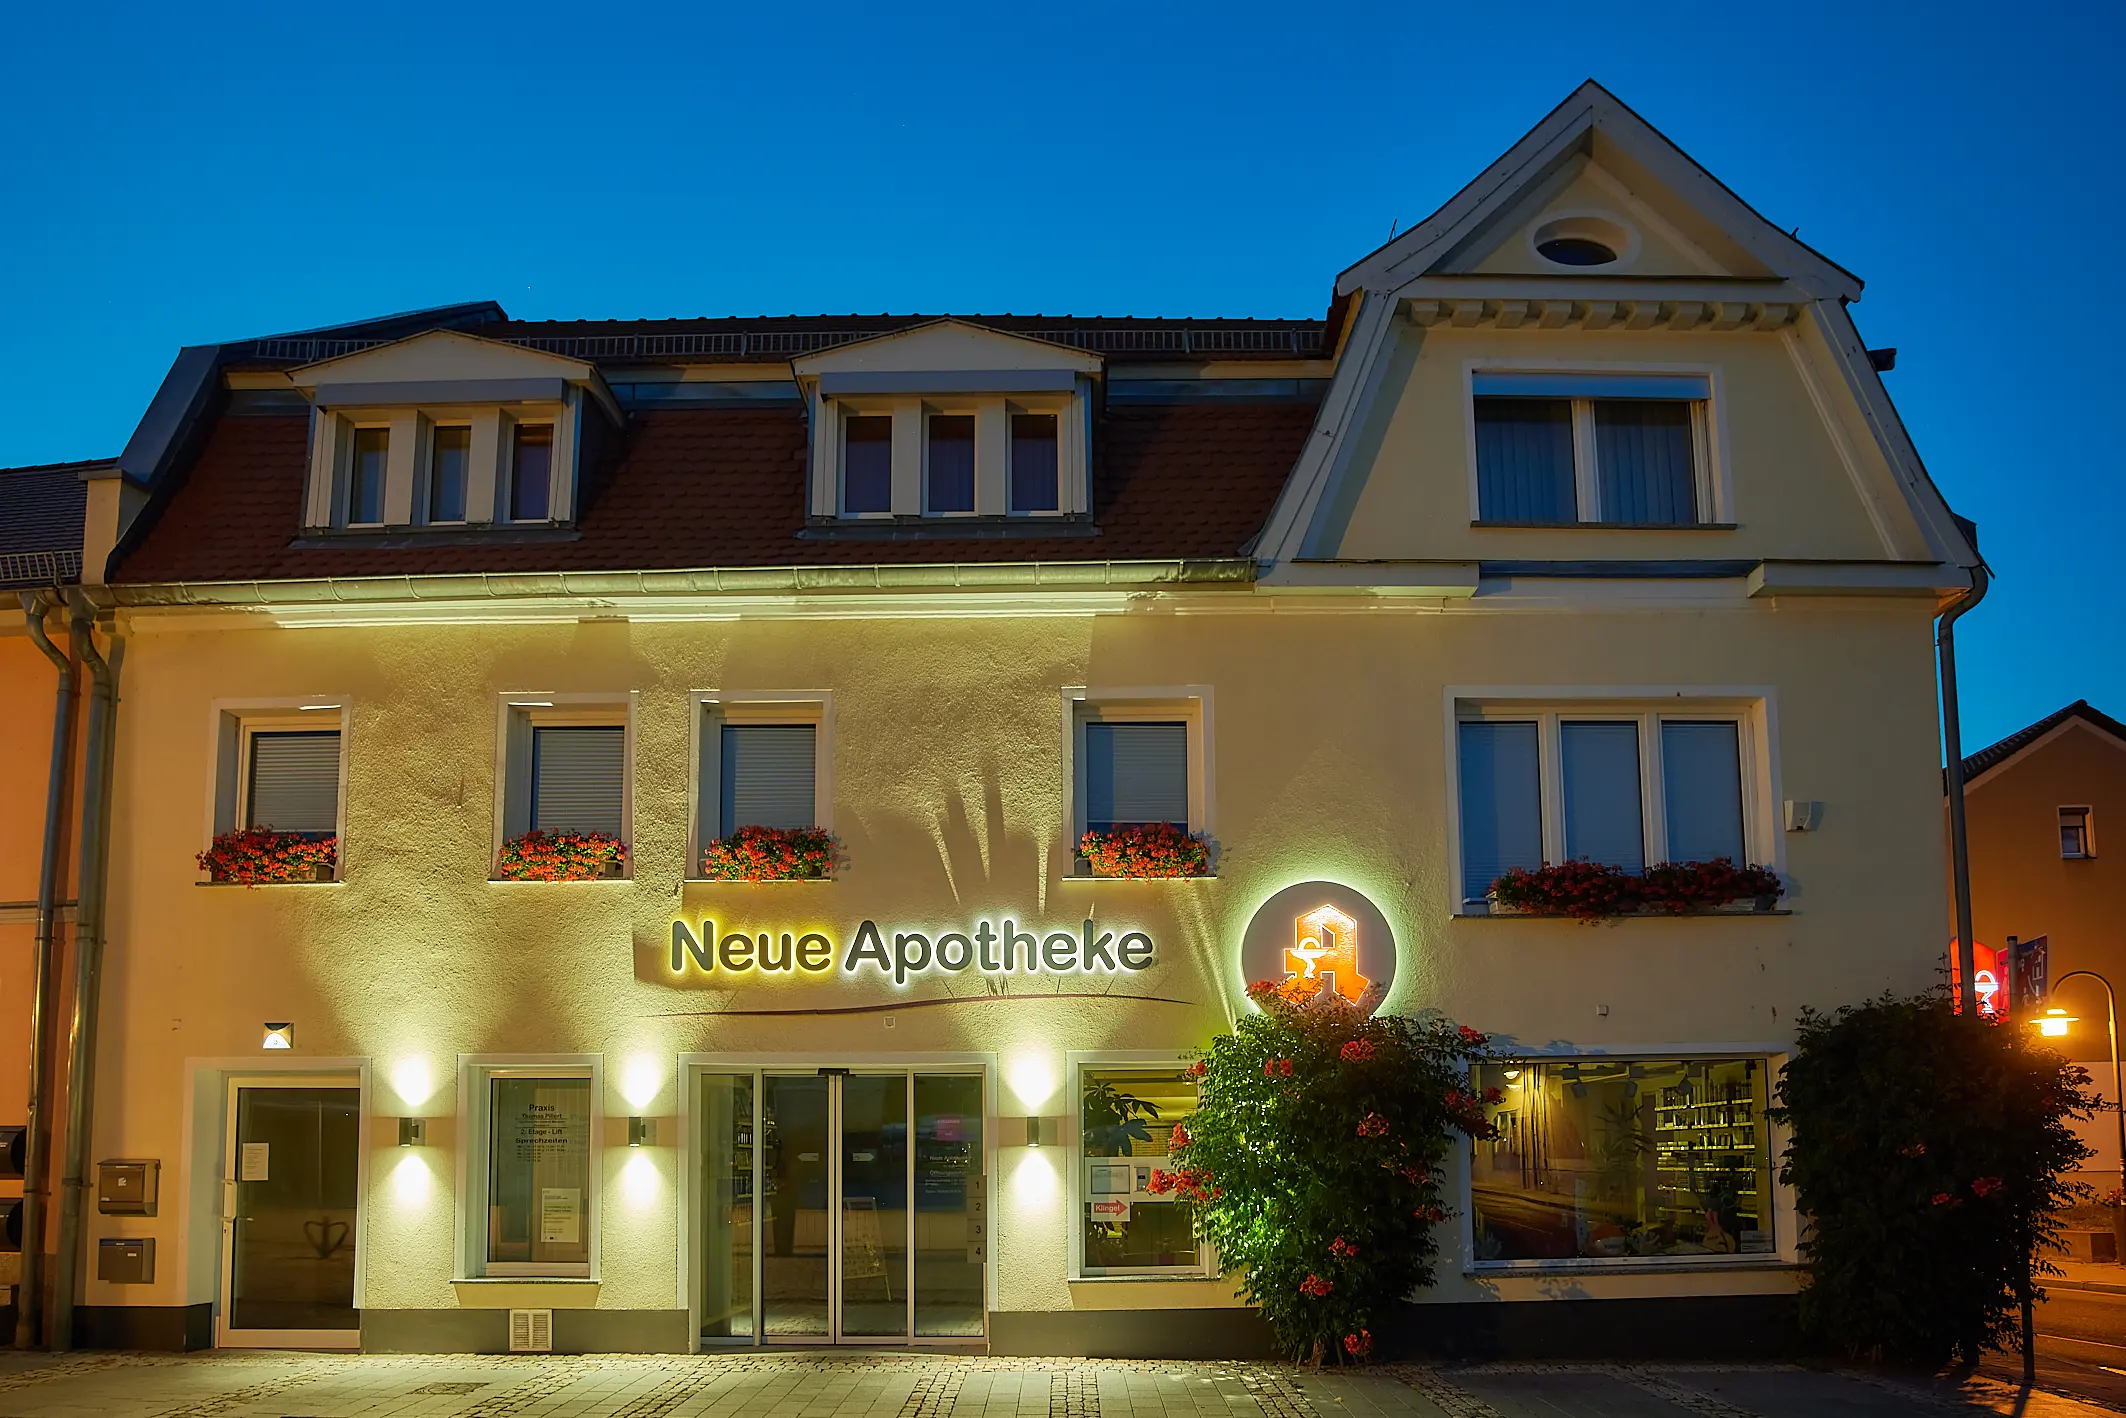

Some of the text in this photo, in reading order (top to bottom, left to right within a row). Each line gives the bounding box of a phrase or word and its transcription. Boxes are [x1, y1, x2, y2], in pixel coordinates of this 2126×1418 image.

[671, 920, 1154, 985] Neue Apotheke
[529, 1103, 555, 1112] Praxis
[528, 1128, 547, 1136] Etage
[515, 1137, 568, 1145] Sprechzeiten
[975, 1202, 981, 1211] 2
[1095, 1205, 1120, 1213] Klingel
[975, 1225, 981, 1234] 3
[975, 1247, 981, 1256] 4
